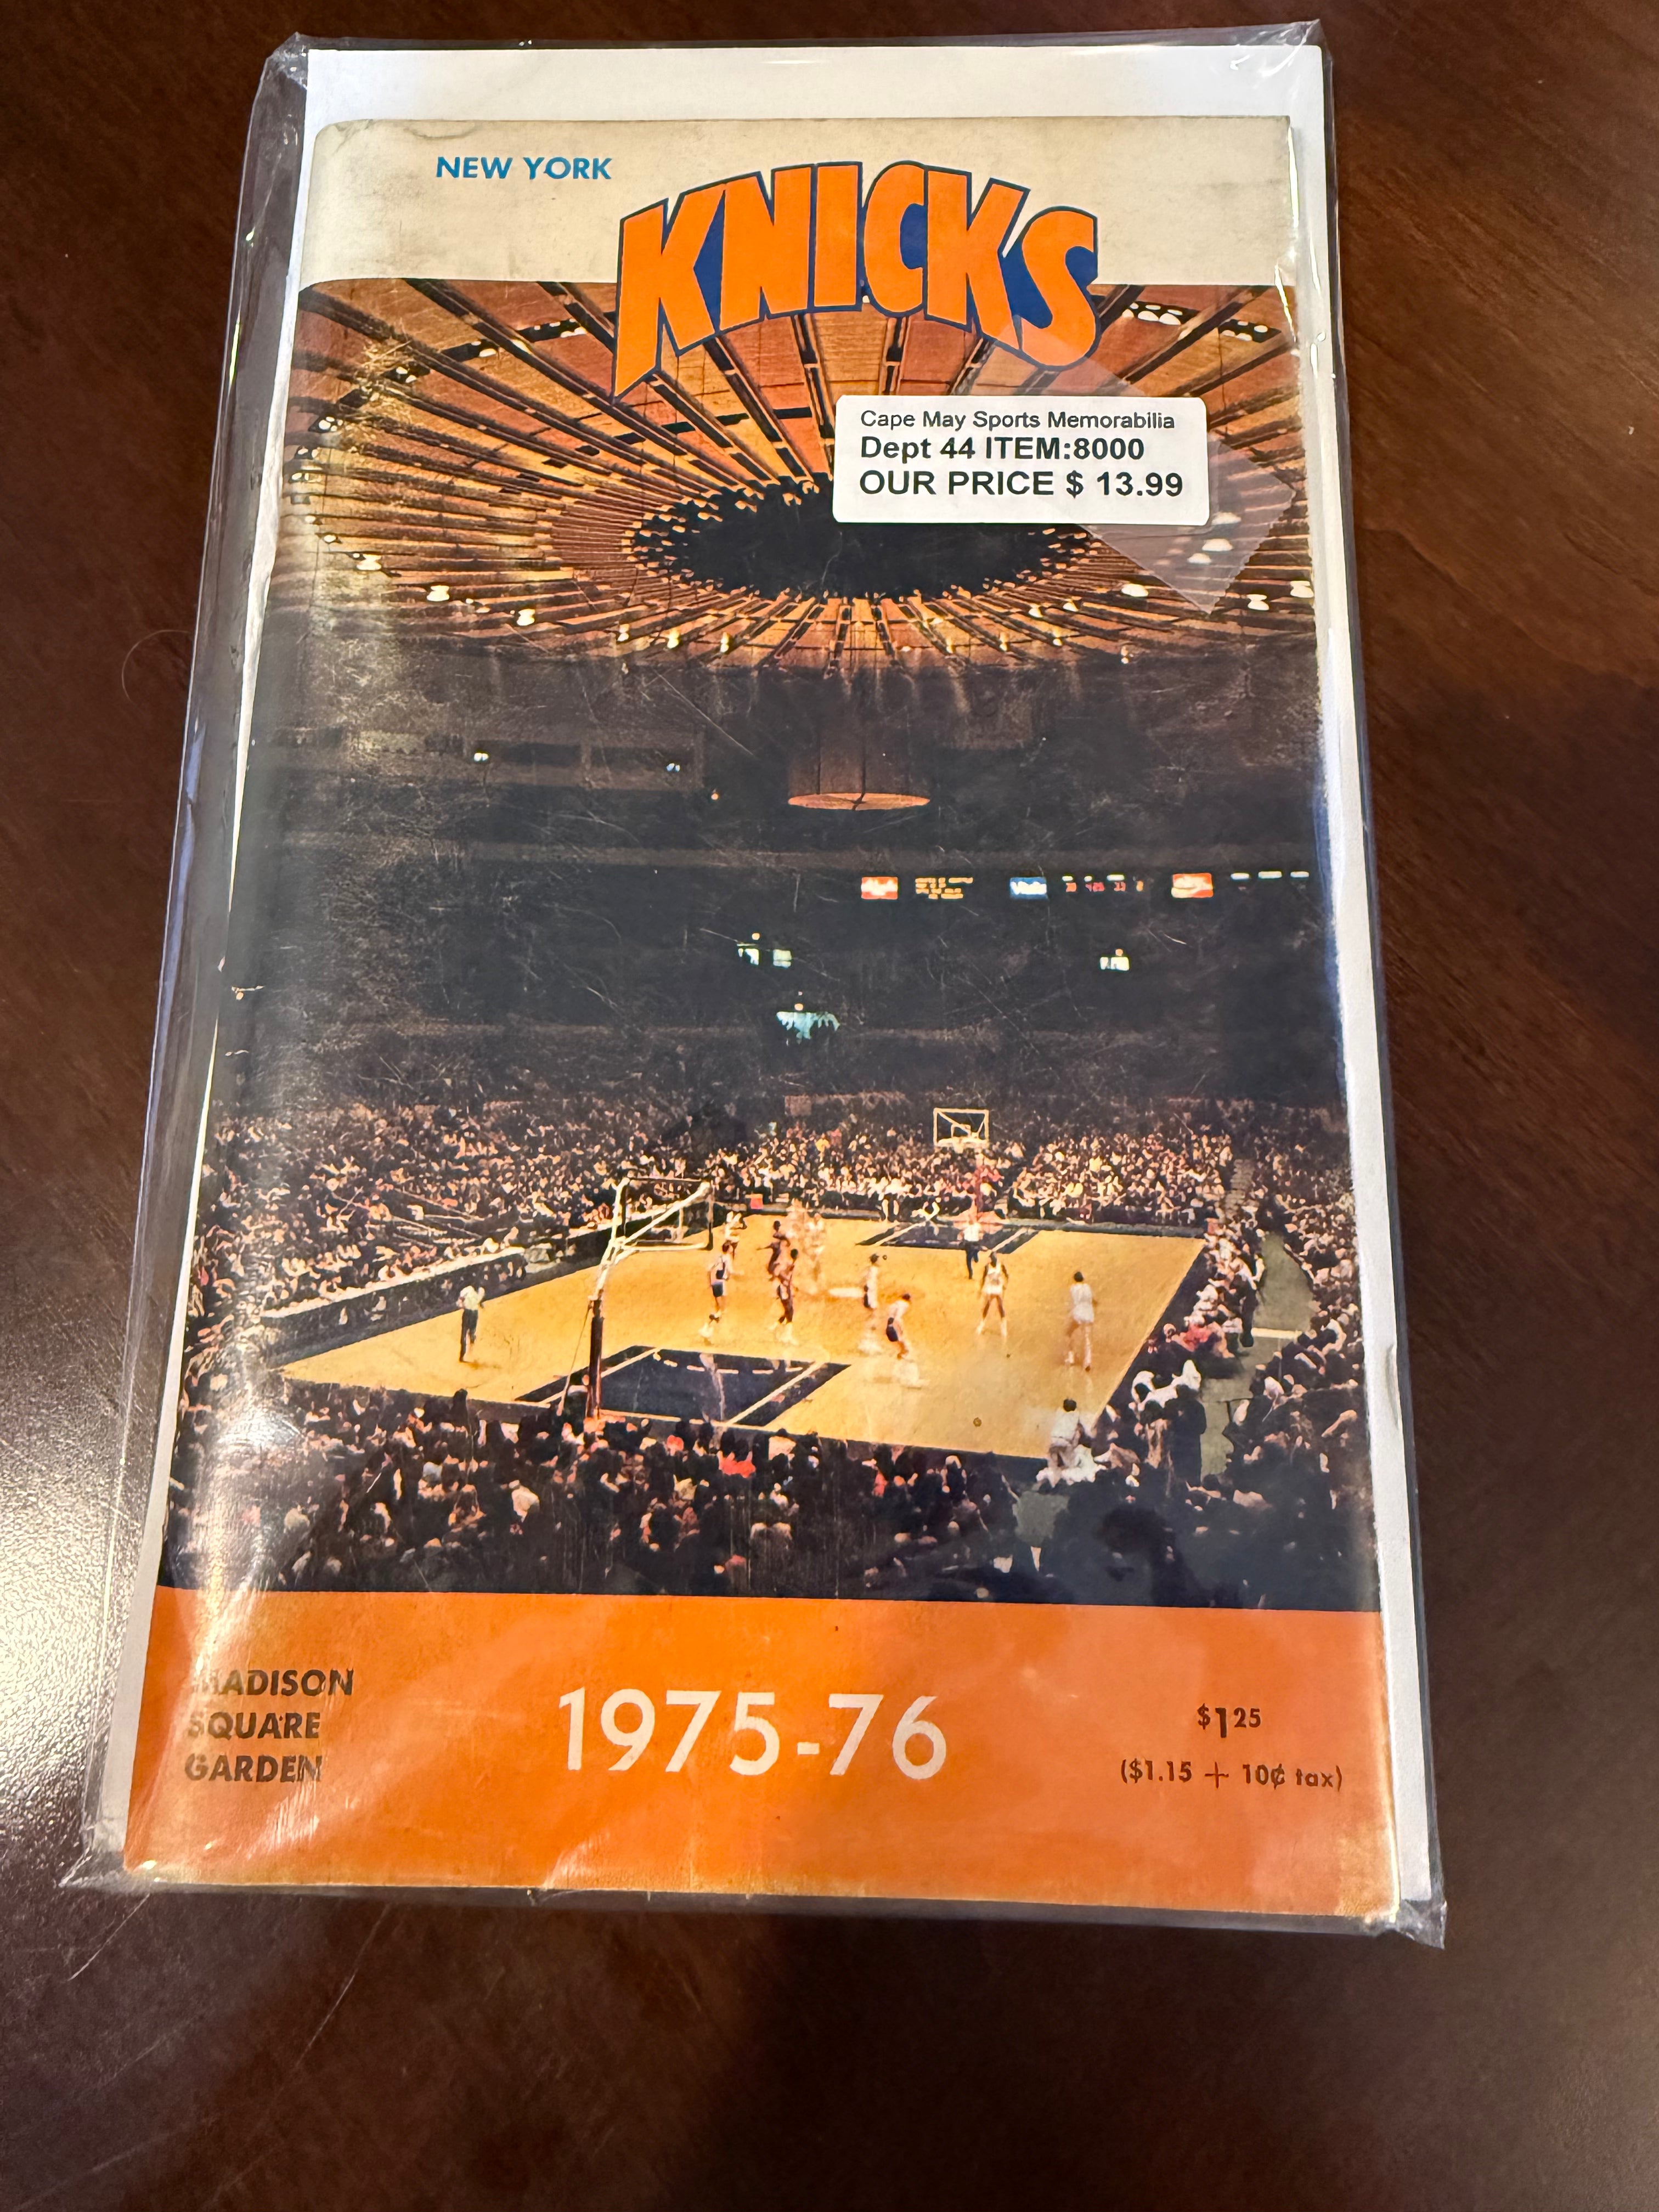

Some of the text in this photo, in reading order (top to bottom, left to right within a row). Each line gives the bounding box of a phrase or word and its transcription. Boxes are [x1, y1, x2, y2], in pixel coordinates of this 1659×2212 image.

[436, 156, 613, 180] NEW YORK
[613, 160, 1098, 400] KNICKS
[861, 410, 1176, 431] Cape May Sports Memorabilia
[860, 436, 1145, 464] Dept 44 ITEM:8000
[859, 470, 1184, 499] OUR PRICE $ 13.99
[192, 1667, 354, 1697] ADISON
[187, 1711, 320, 1740] SQUARE
[558, 1686, 947, 1780] 1975-76
[184, 1753, 323, 1783] GARDEN
[1120, 1758, 1343, 1792] ($1.15 + 10¢ tax)
